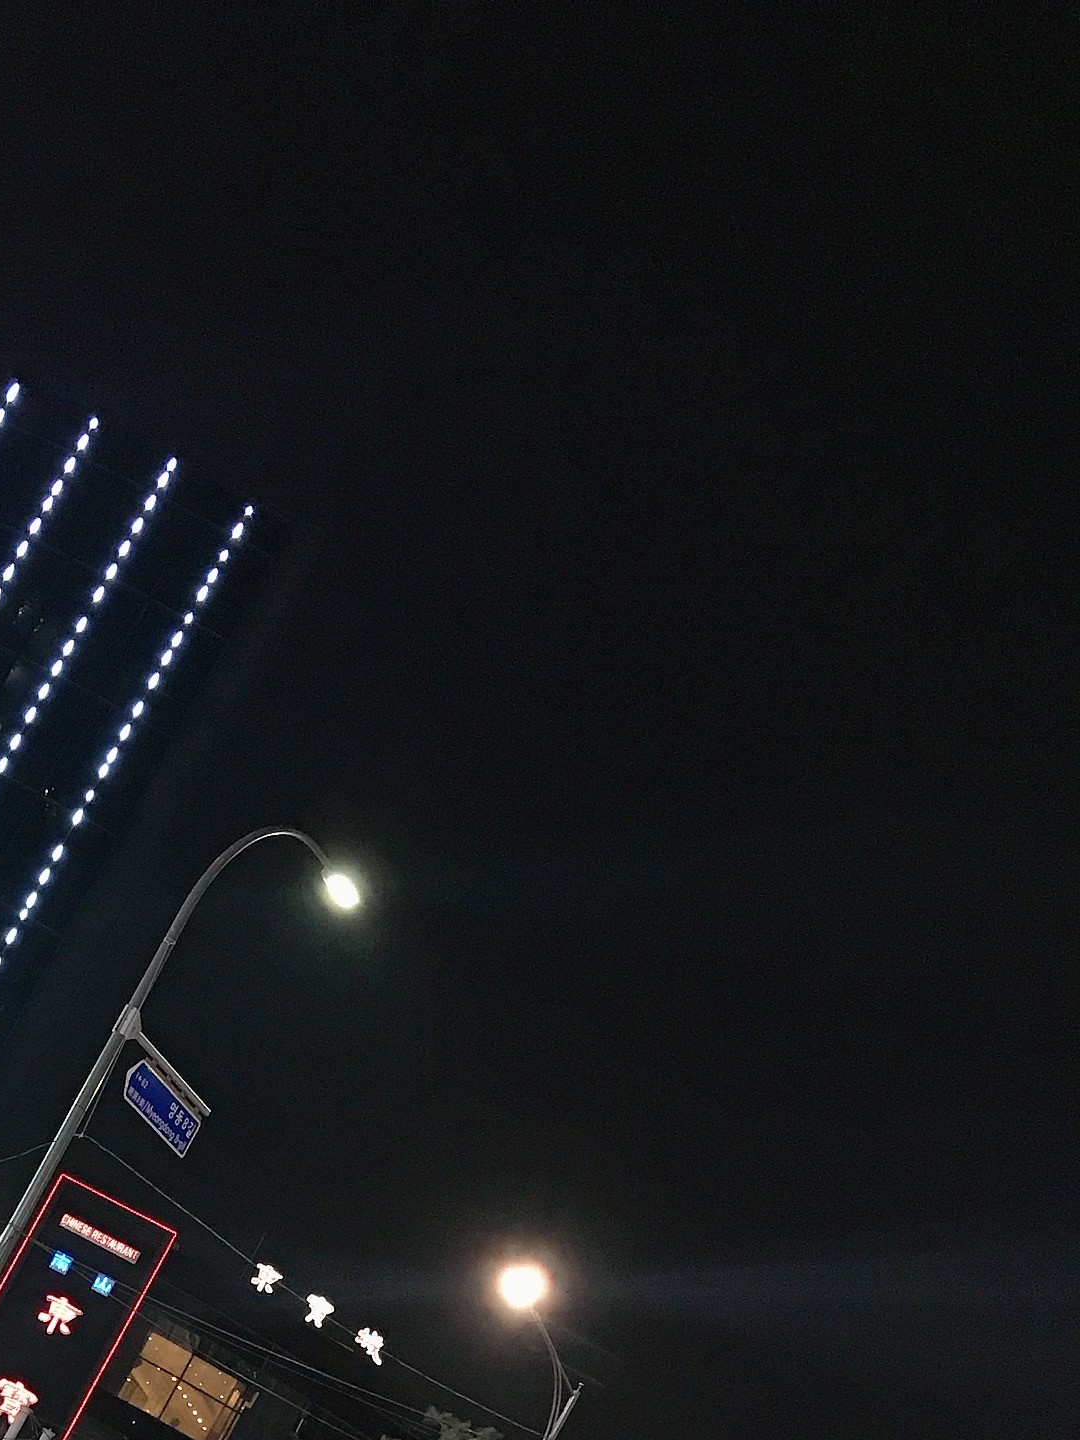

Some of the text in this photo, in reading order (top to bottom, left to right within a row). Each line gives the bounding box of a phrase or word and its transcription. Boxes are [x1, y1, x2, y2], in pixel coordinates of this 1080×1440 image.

[144, 1102, 176, 1141] Myeongdong
[168, 1101, 198, 1139] 명동8길
[60, 1212, 139, 1260] CHINESE RESTAURANT
